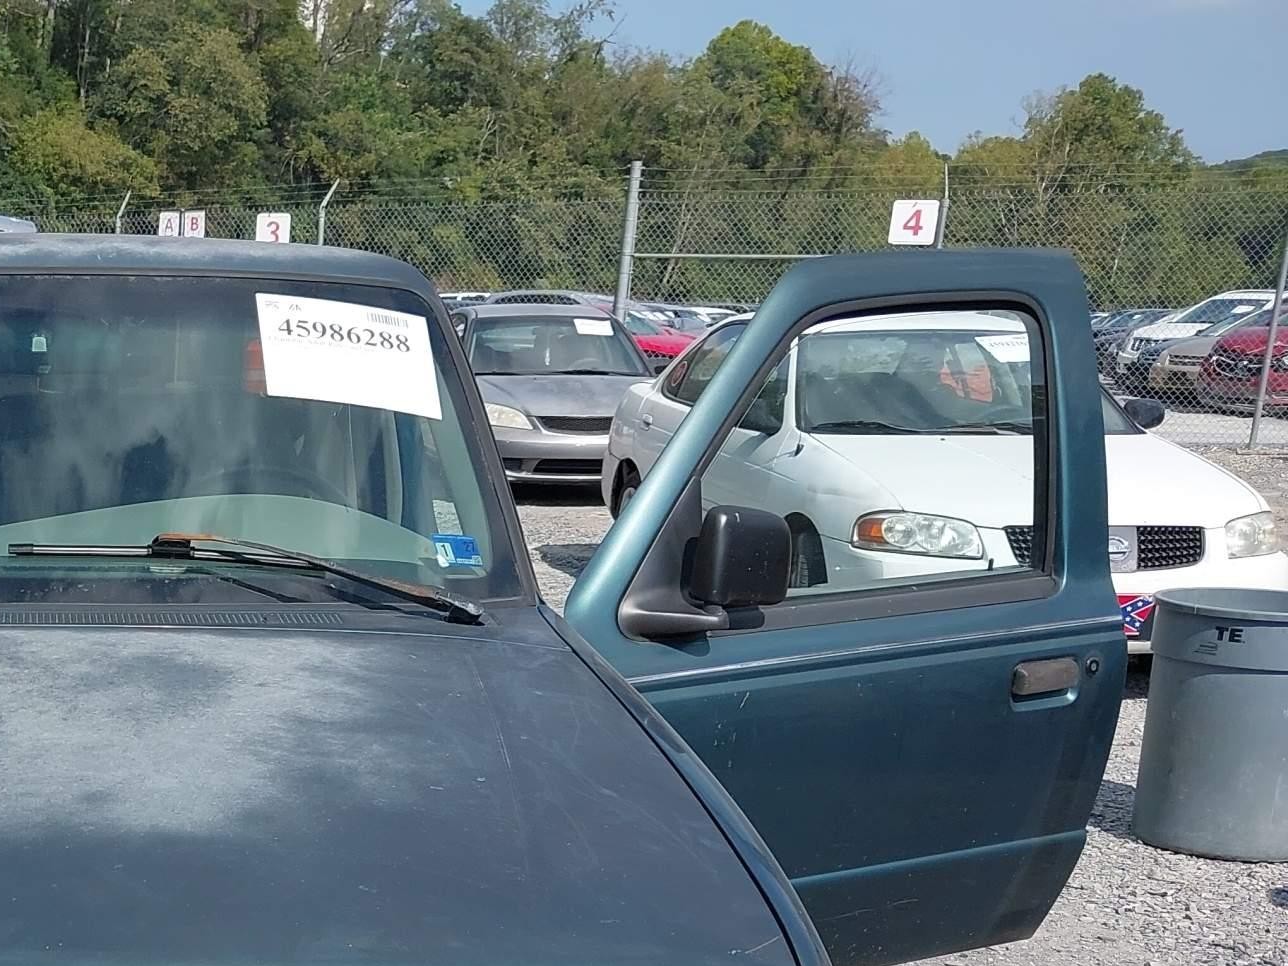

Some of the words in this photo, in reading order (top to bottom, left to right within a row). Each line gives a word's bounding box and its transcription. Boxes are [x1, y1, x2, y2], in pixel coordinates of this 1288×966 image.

[165, 218, 173, 232] A
[191, 217, 199, 231] B
[267, 221, 280, 242] 3
[903, 209, 923, 236] 4
[278, 318, 411, 353] 45986288
